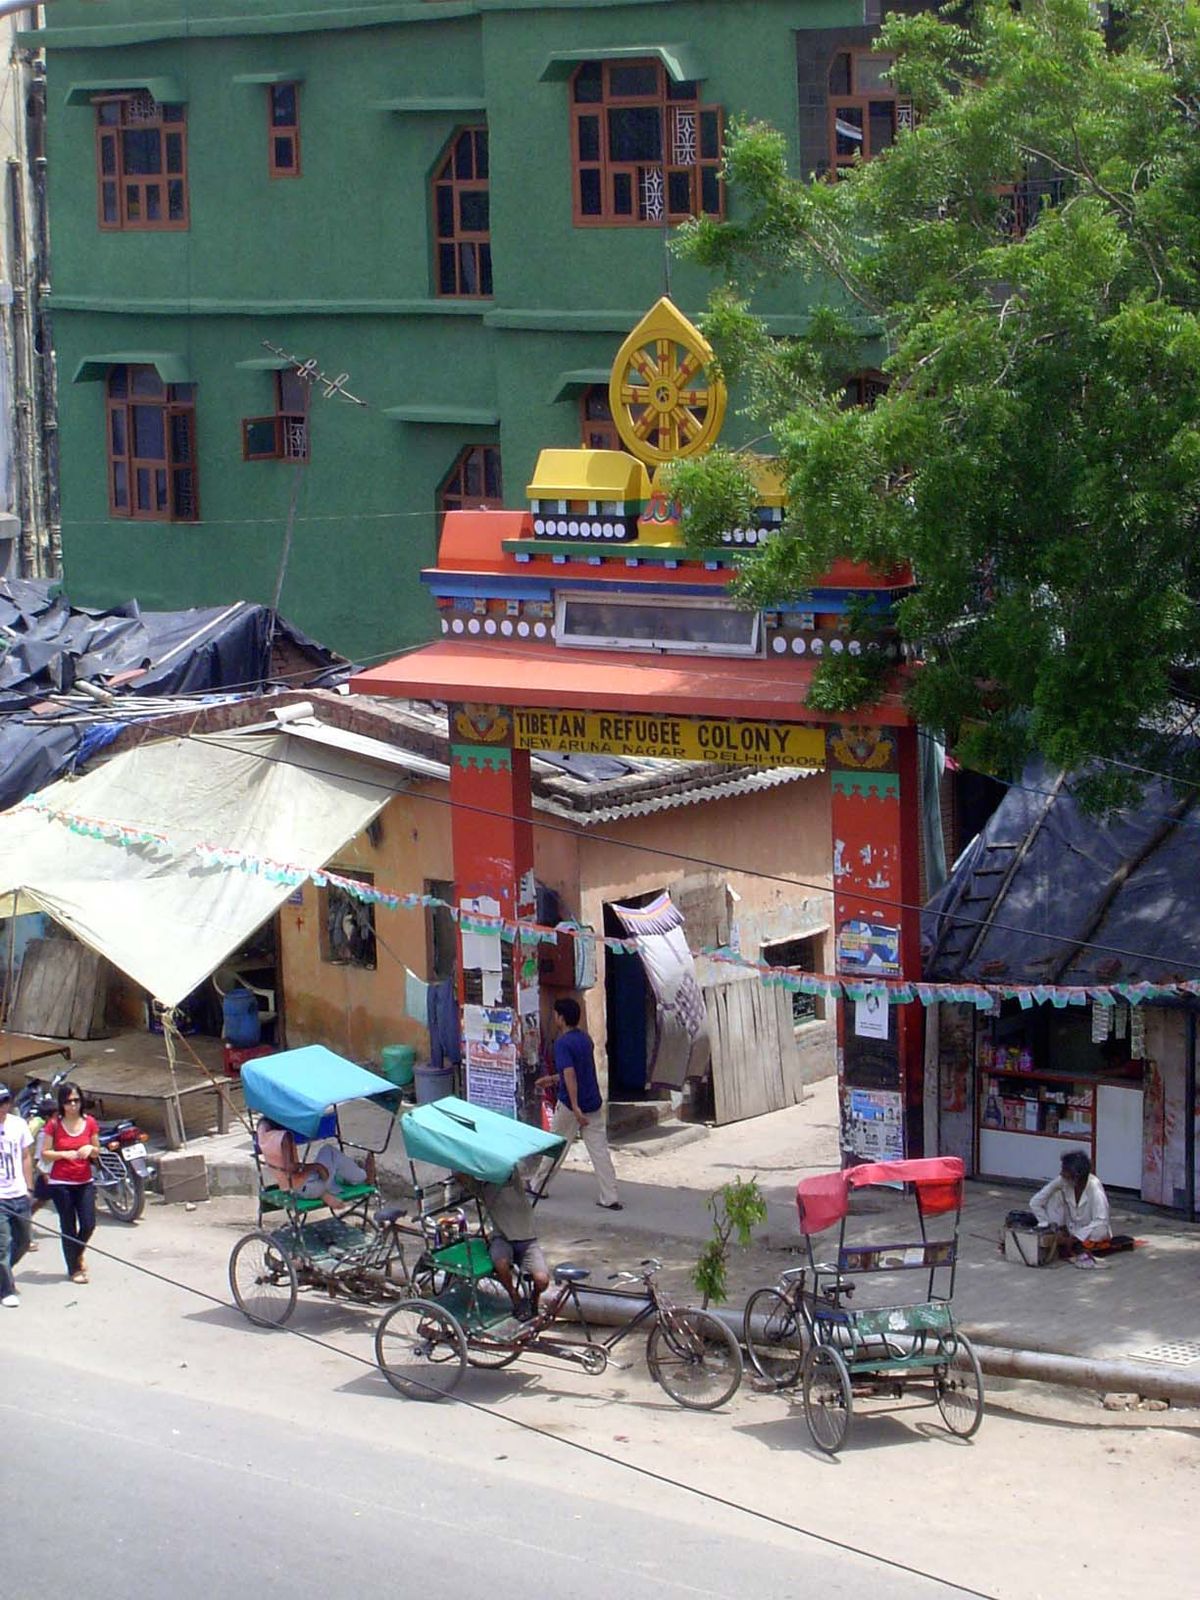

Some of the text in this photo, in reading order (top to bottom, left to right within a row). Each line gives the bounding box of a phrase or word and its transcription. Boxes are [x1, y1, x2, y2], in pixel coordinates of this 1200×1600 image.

[516, 713, 791, 753] TIBETAN REFUGEE COLONY
[519, 736, 552, 750] NEW
[558, 740, 612, 753] ARUNA
[622, 744, 686, 757] NAGAR
